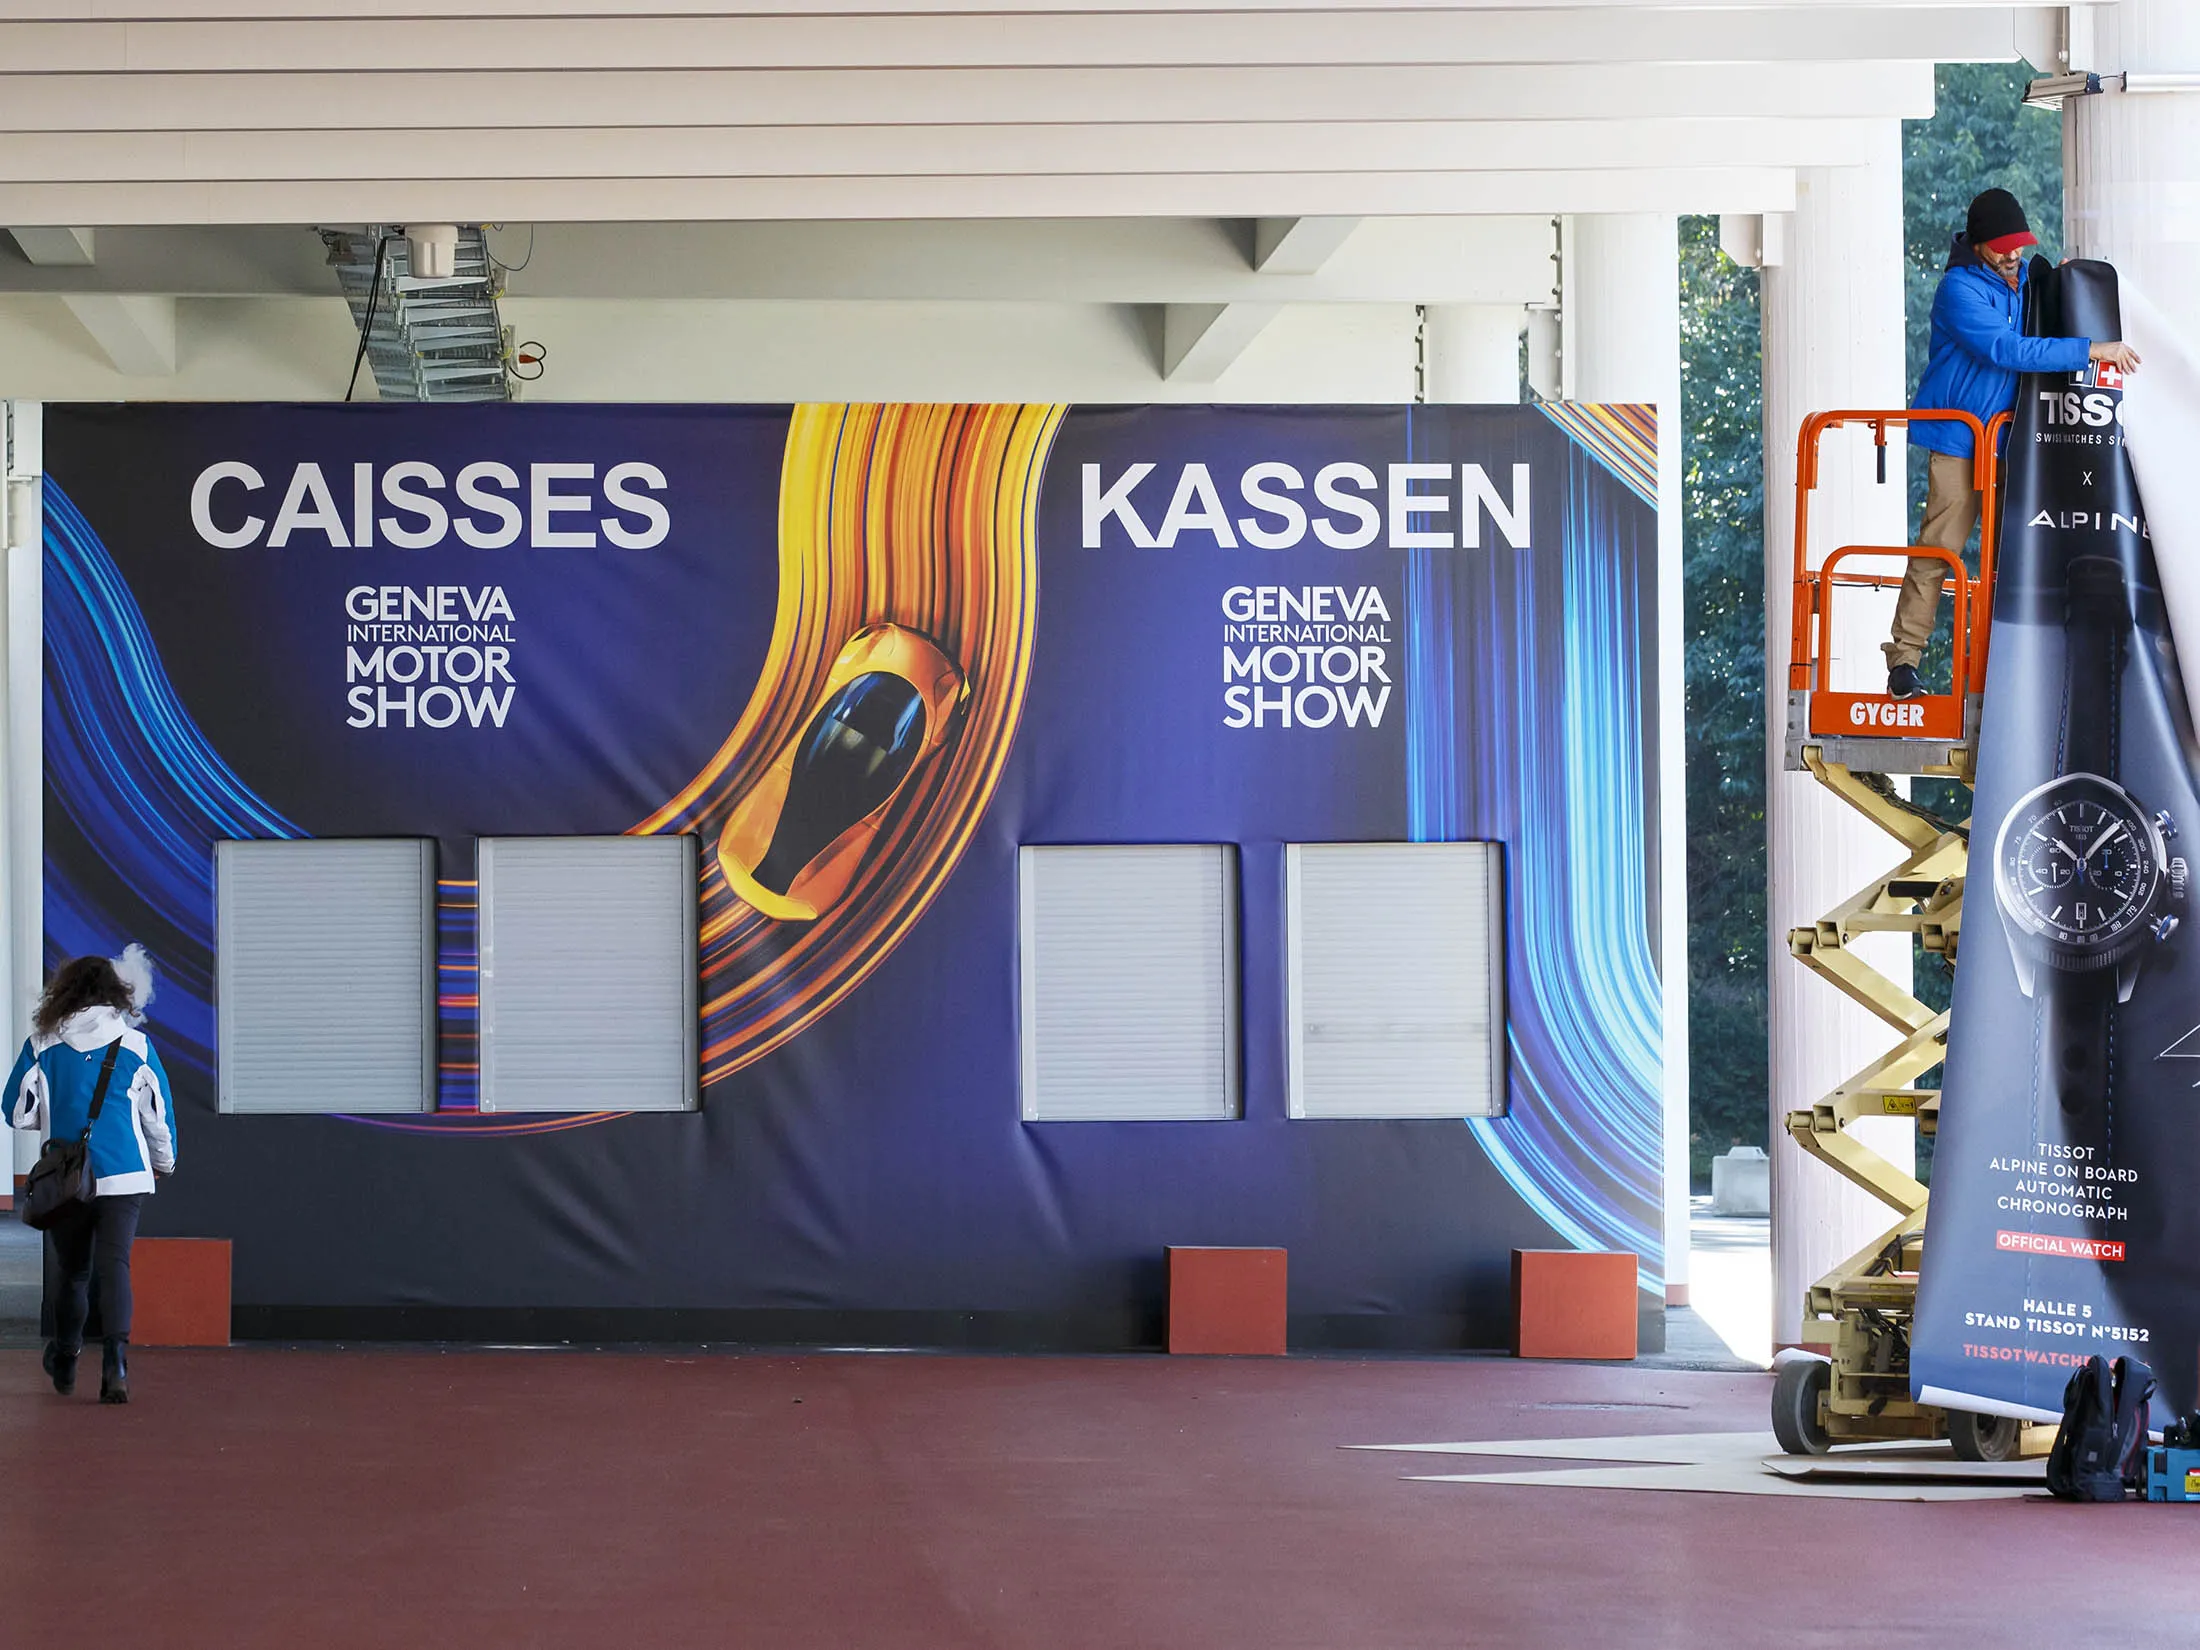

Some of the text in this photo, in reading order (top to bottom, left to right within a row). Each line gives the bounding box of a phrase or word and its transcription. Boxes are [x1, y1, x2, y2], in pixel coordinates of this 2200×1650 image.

[2039, 391, 2124, 427] TISS
[190, 461, 670, 550] CAISSES
[1082, 461, 1531, 550] KASSEN
[346, 585, 516, 622] GENEVA
[1222, 585, 1392, 622] GENEVA
[347, 624, 516, 643] INTERNATIONAL
[1223, 624, 1392, 643] INTERNATIONAL
[346, 646, 516, 684] MOTOR
[1222, 646, 1392, 684] MOTOR
[346, 686, 516, 729] SHOW
[1222, 686, 1392, 729] SHOW
[1850, 702, 1925, 727] GYGER
[2038, 1142, 2095, 1160] TISSOT
[1989, 1158, 2138, 1183] ALPINE ON BOARD
[2015, 1179, 2113, 1200] AUTOMATIC
[1997, 1196, 2128, 1221] CHRONOGRAPH
[1999, 1234, 2123, 1258] OFFICIAL WATCH
[2023, 1298, 2092, 1318] HALLE 5
[1964, 1312, 2150, 1342] STAND TISSOT N°5152
